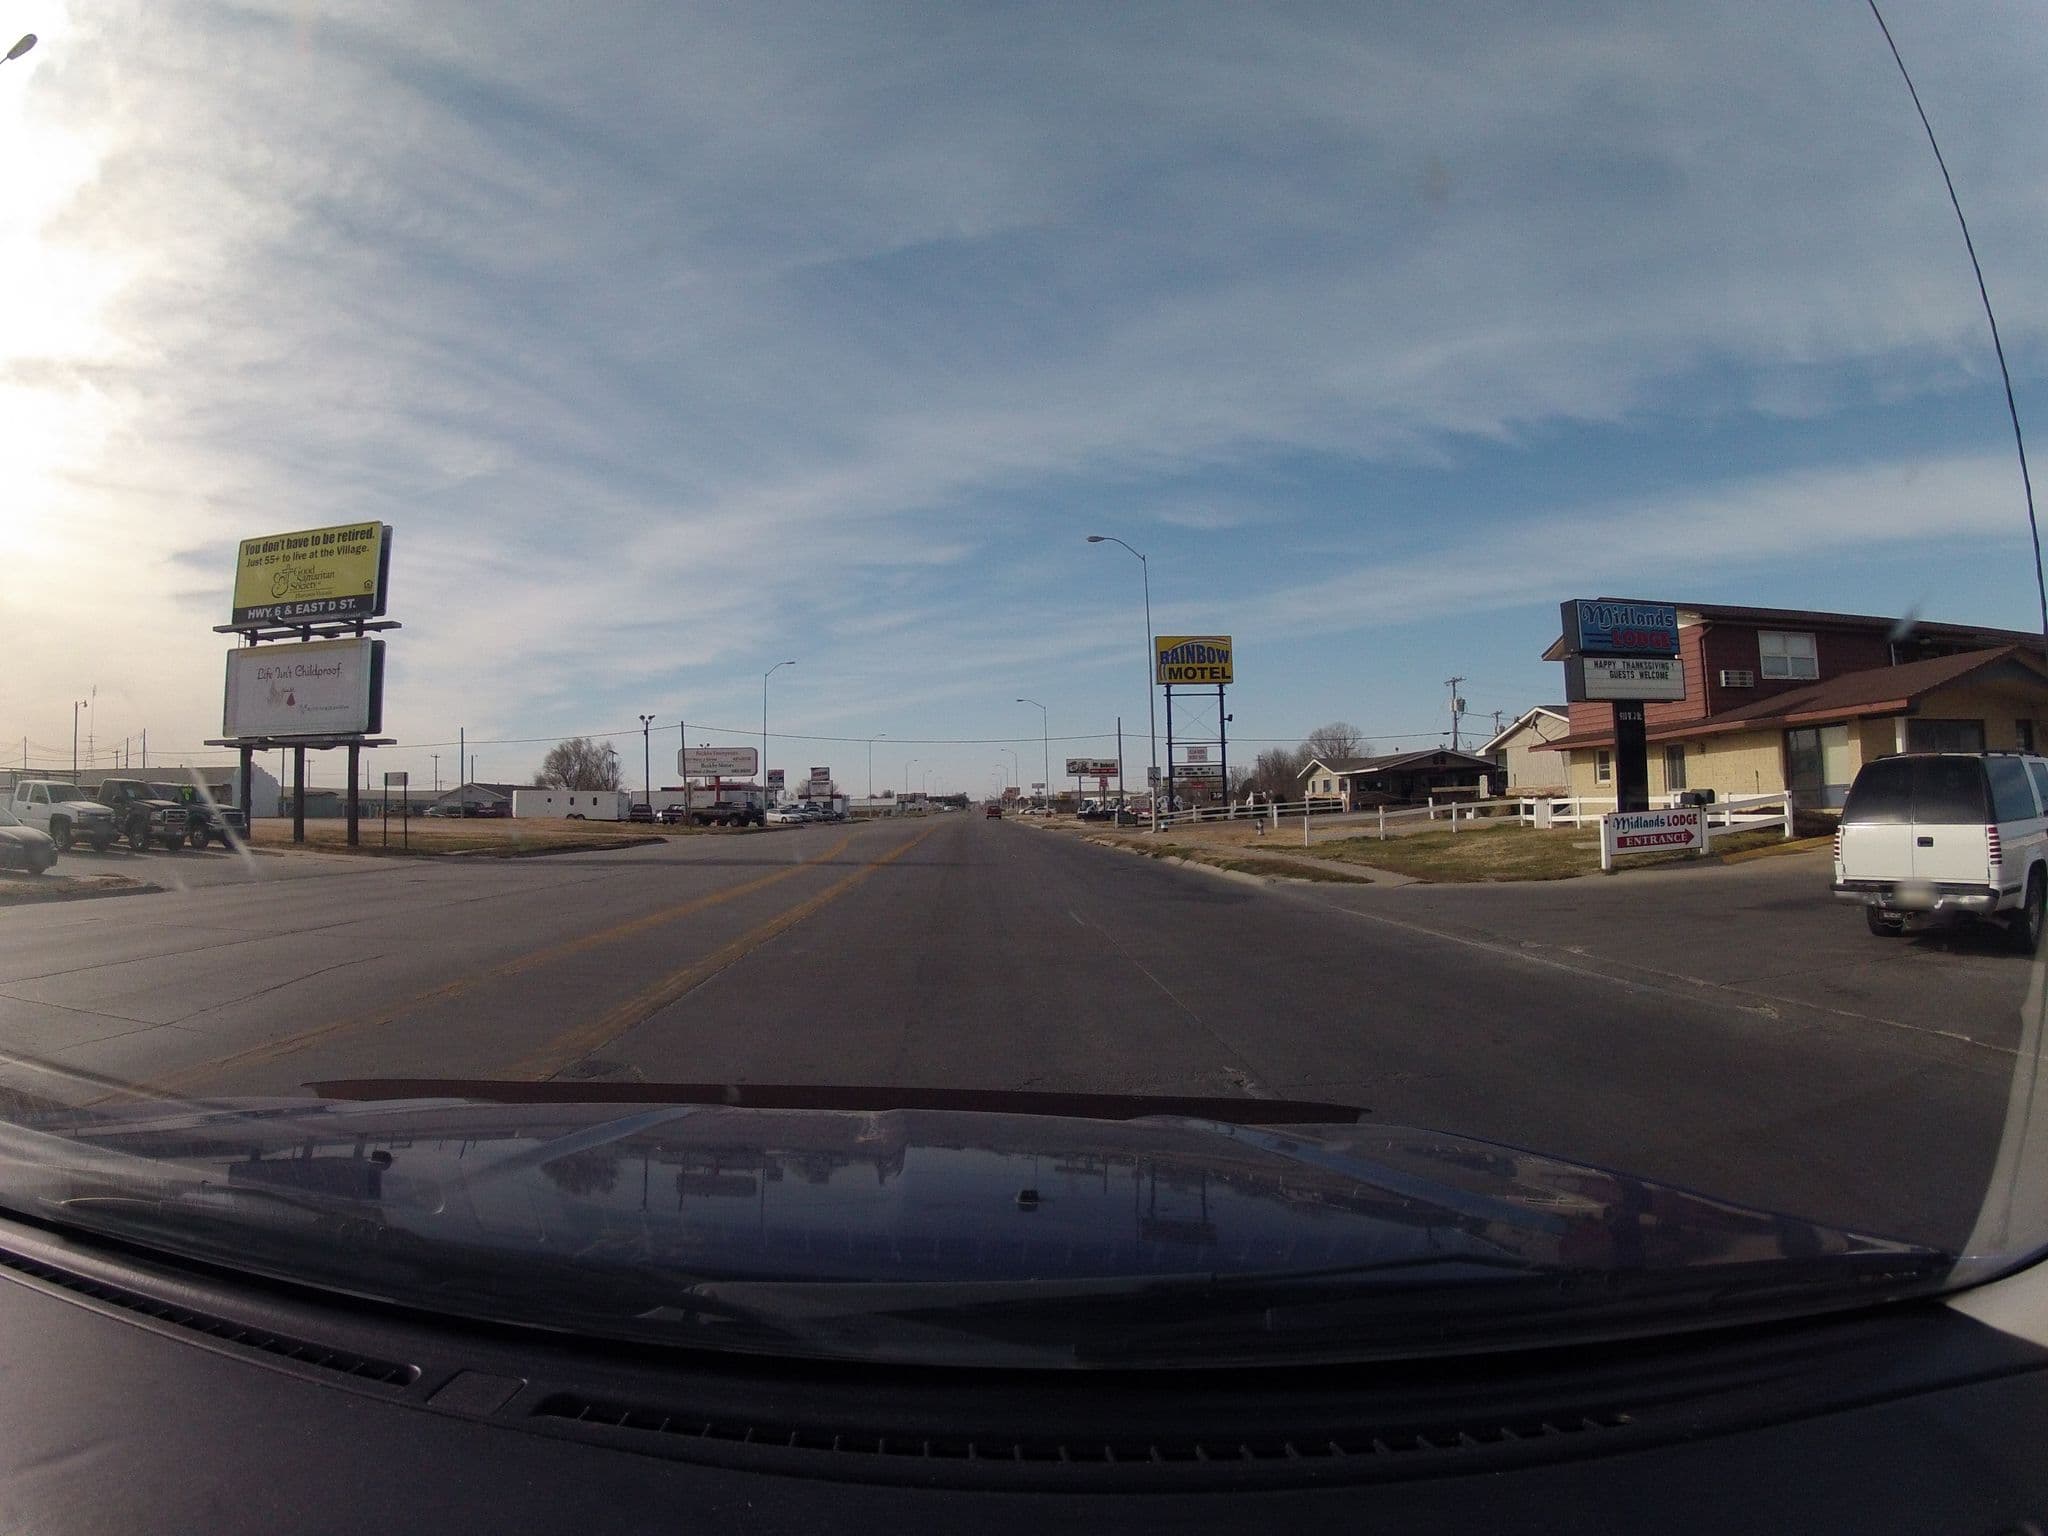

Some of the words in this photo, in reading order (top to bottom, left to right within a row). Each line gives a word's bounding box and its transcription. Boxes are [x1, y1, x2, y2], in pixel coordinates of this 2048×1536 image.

[245, 543, 259, 556] You
[262, 539, 285, 554] don't
[286, 537, 308, 550] have
[311, 535, 320, 546] to
[322, 533, 335, 545] be
[337, 527, 375, 543] retired.
[246, 557, 262, 568] Just
[264, 554, 280, 565] 55+
[282, 553, 291, 563] to
[292, 550, 307, 561] live
[309, 549, 318, 559] at
[320, 547, 334, 558] the
[337, 544, 370, 557] Village.
[248, 607, 273, 619] HWY.
[274, 605, 281, 615] 6
[284, 604, 293, 615] &
[295, 601, 325, 614] EAST
[328, 601, 337, 611] D
[339, 598, 356, 610] ST.
[1583, 605, 1674, 631] Midlands
[1612, 629, 1671, 649] LODGE
[1160, 643, 1229, 665] RAINBOW
[257, 667, 273, 682] Life
[1168, 667, 1231, 680] MOTEL
[1594, 660, 1616, 670] HAPPY
[1609, 671, 1635, 680] GUESTS
[1639, 671, 1669, 680] WELCOME
[1613, 815, 1665, 834] Midlands
[1667, 814, 1697, 827] LODGE
[1626, 832, 1688, 846] ENTRANCE
